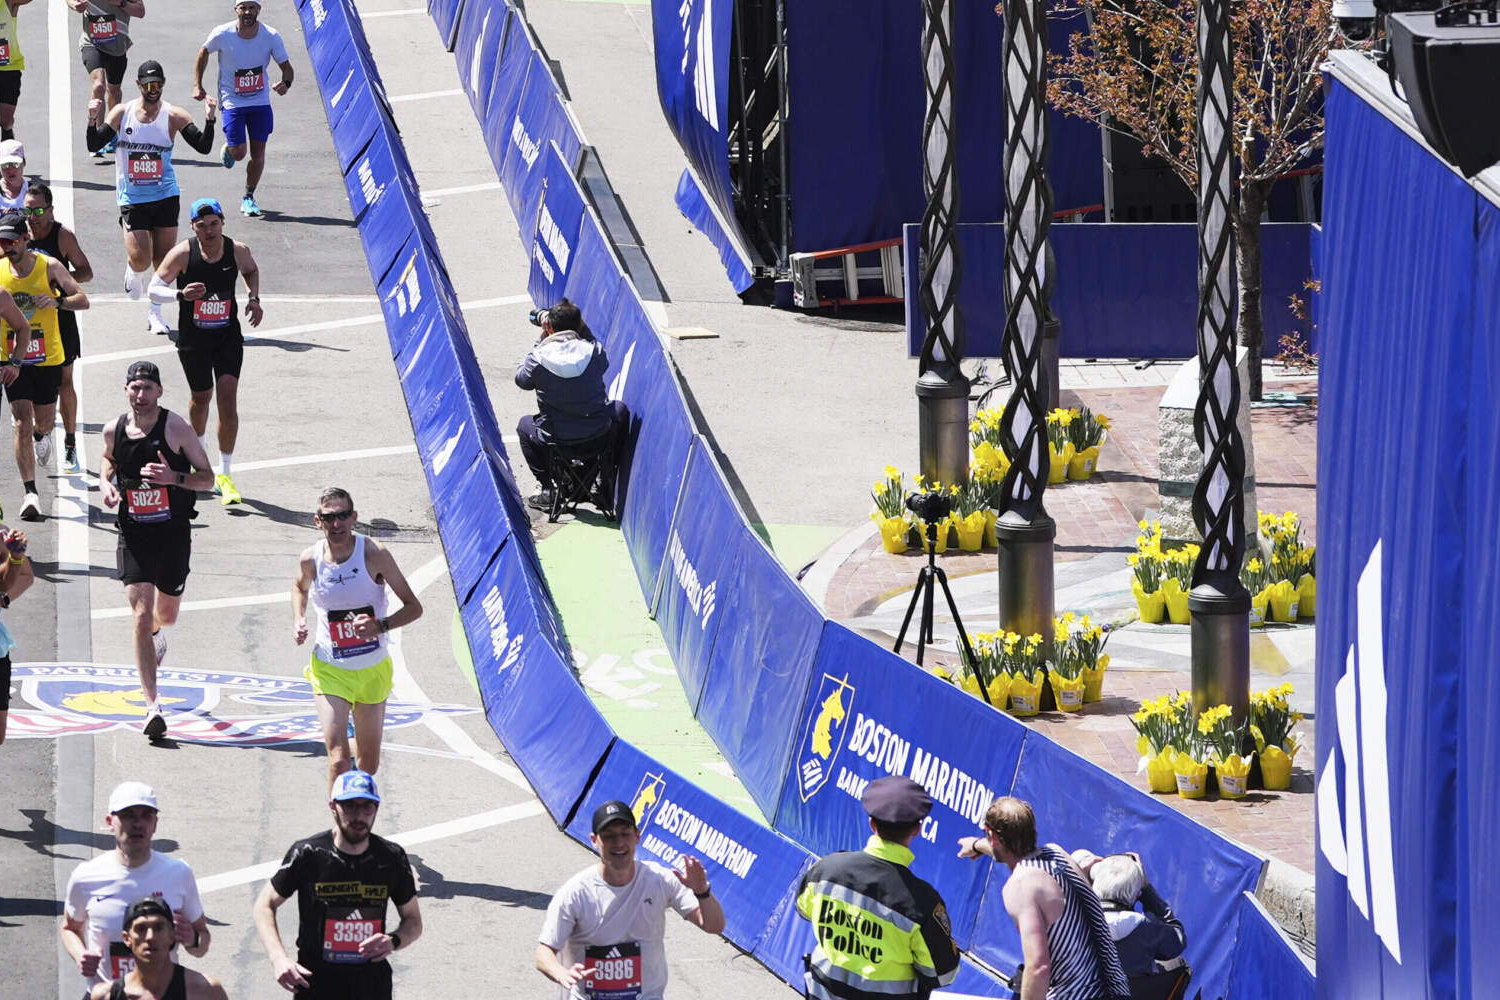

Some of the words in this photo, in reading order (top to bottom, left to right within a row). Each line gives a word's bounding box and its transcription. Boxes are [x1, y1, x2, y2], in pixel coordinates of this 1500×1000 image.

[134, 160, 157, 174] 6483
[199, 301, 226, 315] 4805
[131, 491, 161, 506] 5022
[848, 713, 910, 777] BOSTON
[836, 766, 869, 800] BANK
[655, 799, 702, 847] BOSTON
[695, 818, 758, 880] MARATHON
[363, 886, 388, 898] HALF
[818, 899, 883, 940] Boston
[334, 922, 374, 943] 3339
[818, 930, 884, 965] Police
[594, 959, 633, 981] 3986
